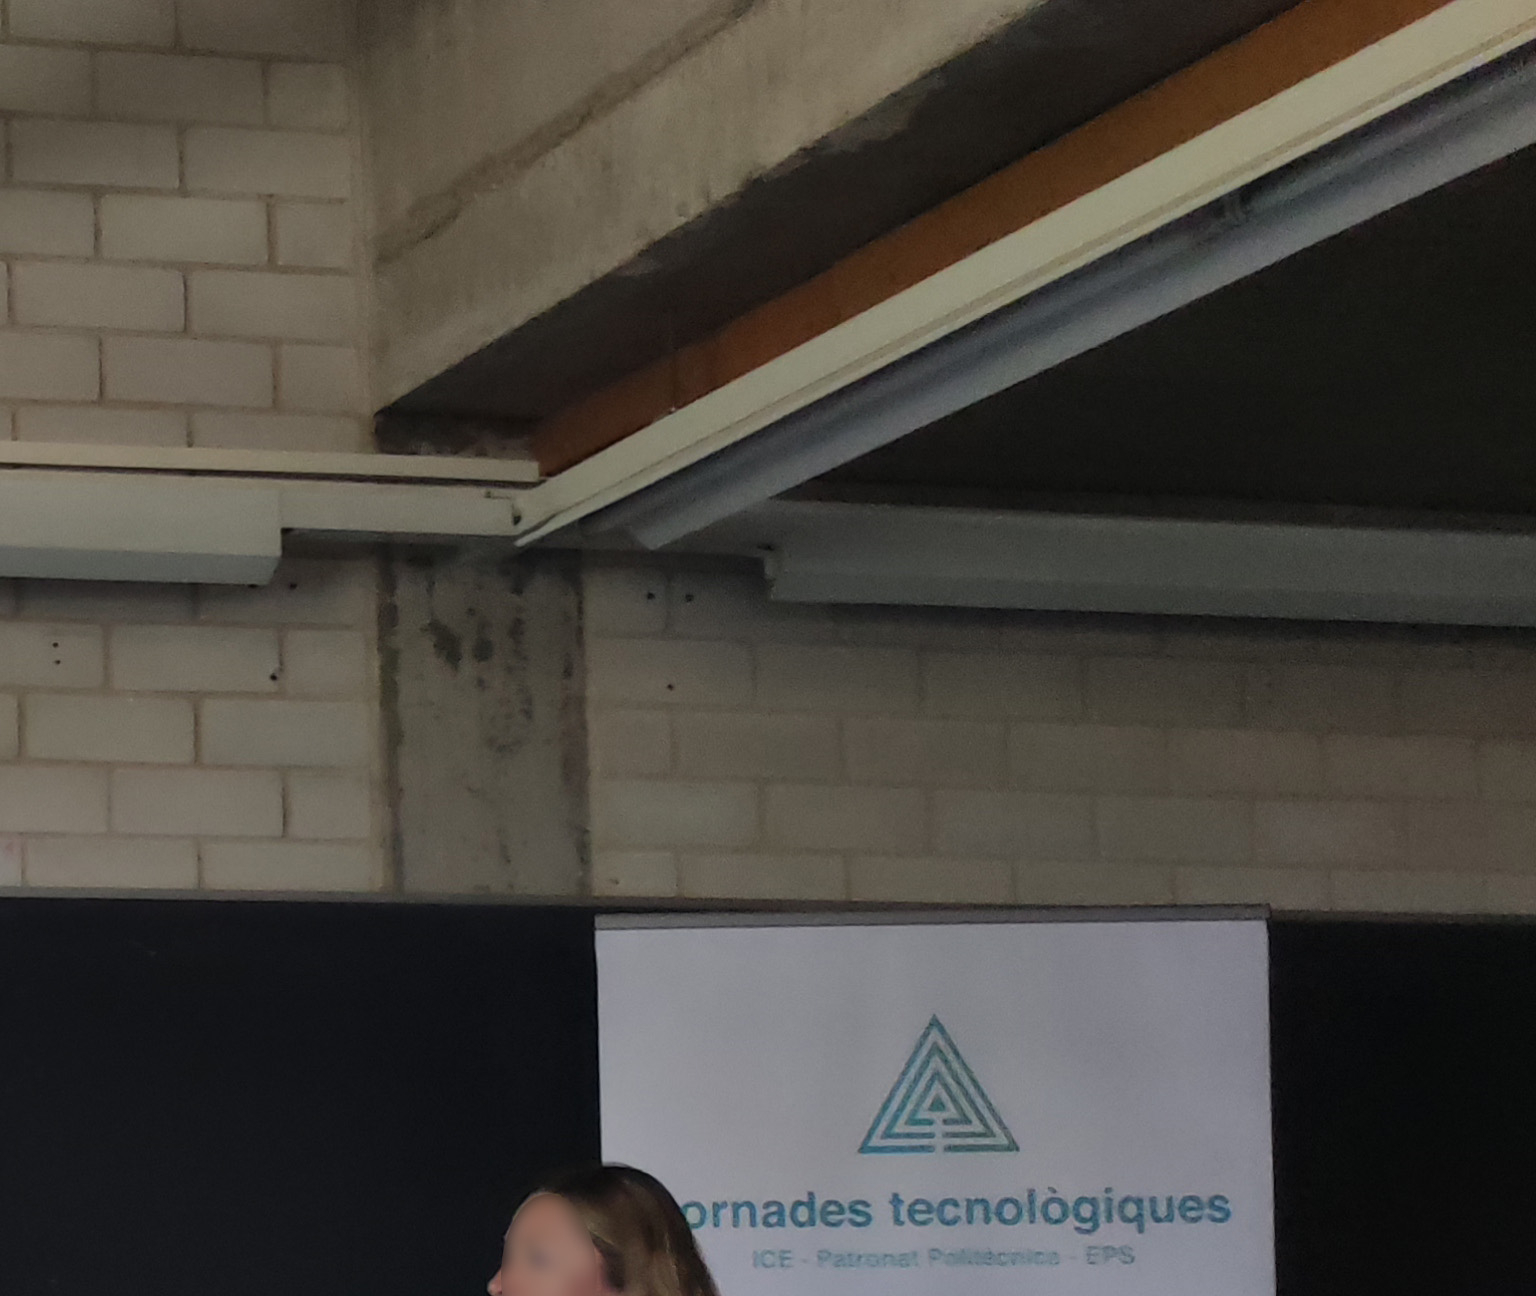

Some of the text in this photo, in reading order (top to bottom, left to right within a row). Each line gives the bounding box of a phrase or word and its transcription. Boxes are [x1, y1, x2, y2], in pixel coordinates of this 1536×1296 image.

[678, 1187, 1233, 1235] ornades tecnològiques
[752, 1249, 795, 1269] ICE
[1085, 1245, 1136, 1266] EPS
